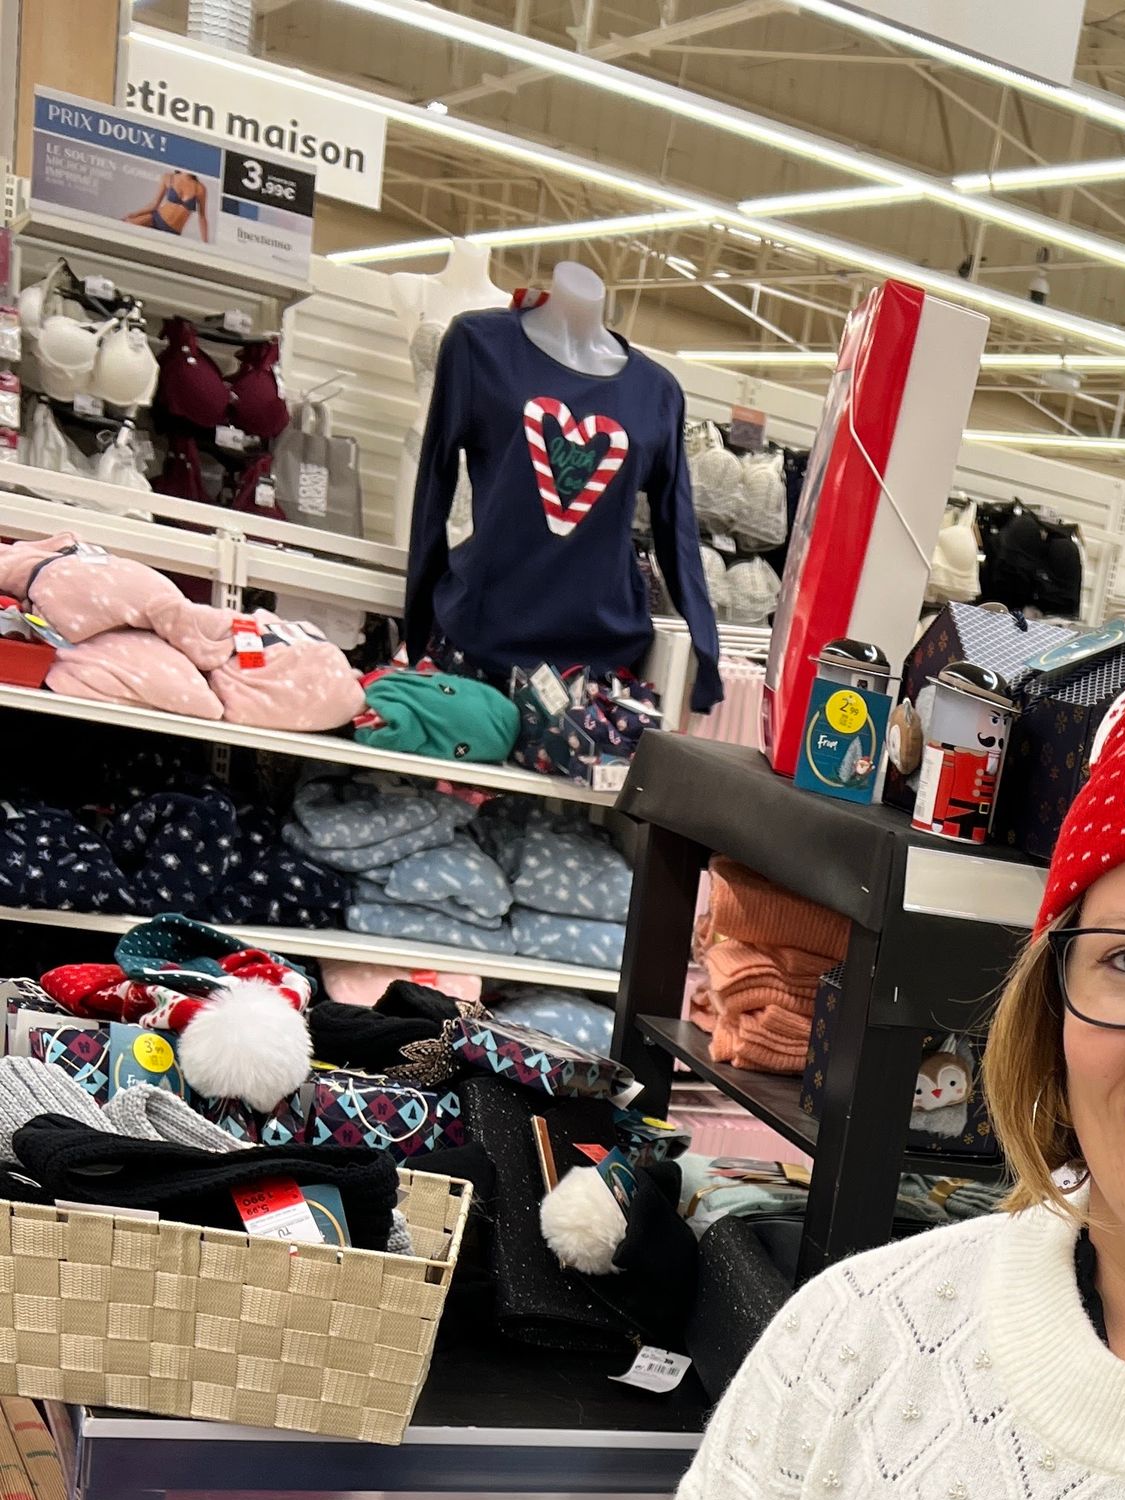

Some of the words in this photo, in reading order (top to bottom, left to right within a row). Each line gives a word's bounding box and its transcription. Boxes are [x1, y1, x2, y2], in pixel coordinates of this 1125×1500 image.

[48, 104, 93, 132] PRIX
[98, 118, 155, 150] DOUX
[226, 111, 364, 173] maison
